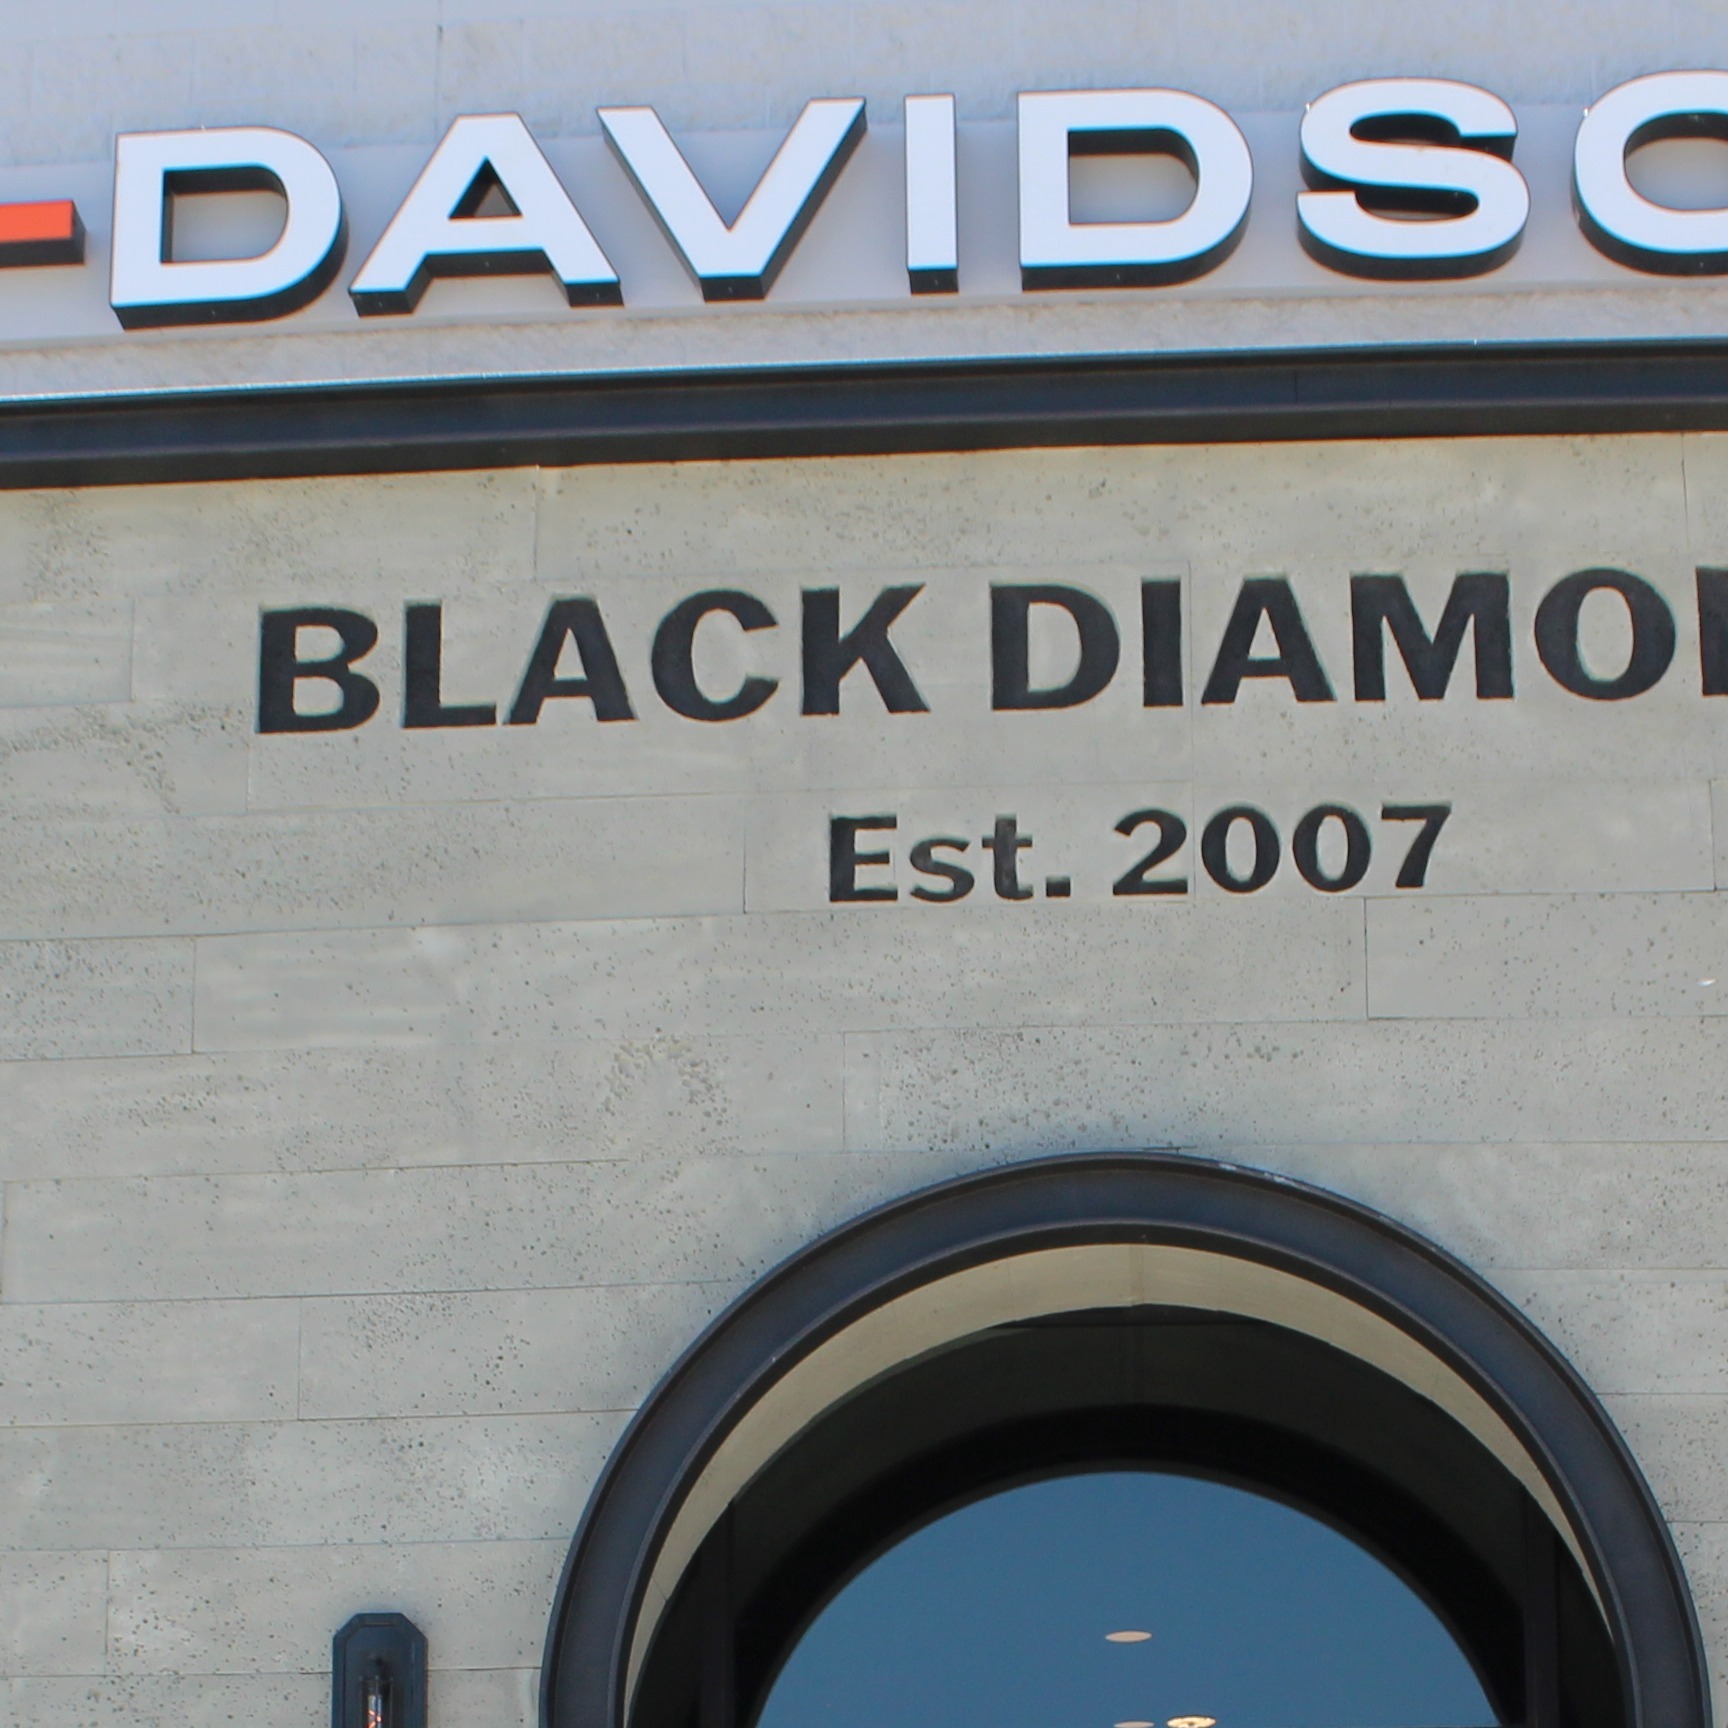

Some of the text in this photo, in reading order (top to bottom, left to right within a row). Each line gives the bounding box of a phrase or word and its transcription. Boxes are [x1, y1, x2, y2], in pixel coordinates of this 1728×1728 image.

[258, 585, 929, 733] BLACK
[830, 805, 1450, 902] Est. 2007
